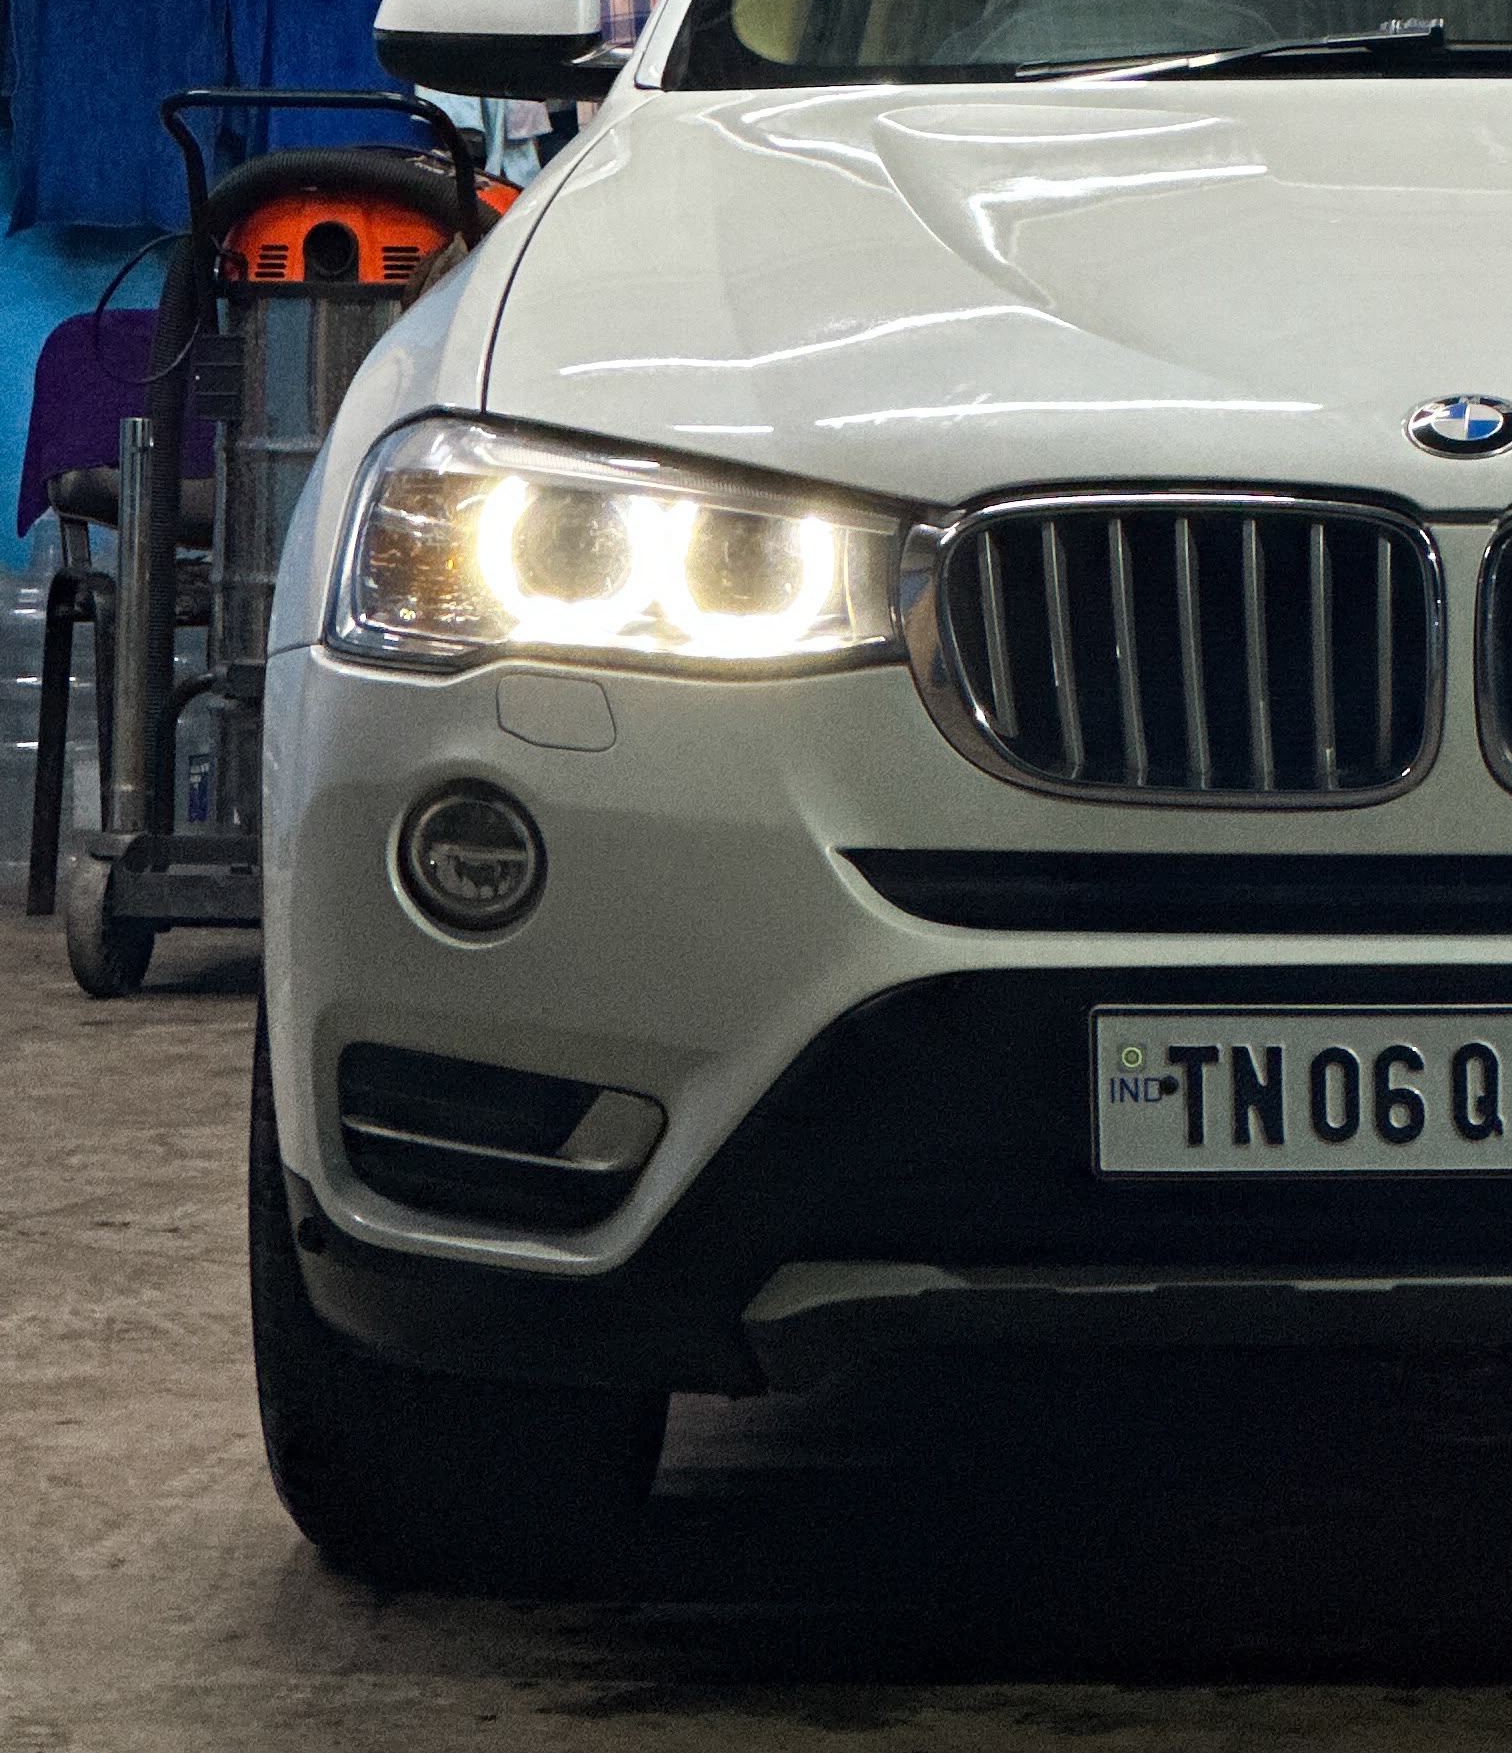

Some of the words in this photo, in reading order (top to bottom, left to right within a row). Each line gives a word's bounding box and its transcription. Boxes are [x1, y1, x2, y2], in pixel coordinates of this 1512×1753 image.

[1109, 1076, 1164, 1104] IND
[1167, 1045, 1285, 1147] TN
[1309, 1044, 1426, 1145] 06
[1451, 1042, 1504, 1141] Q
